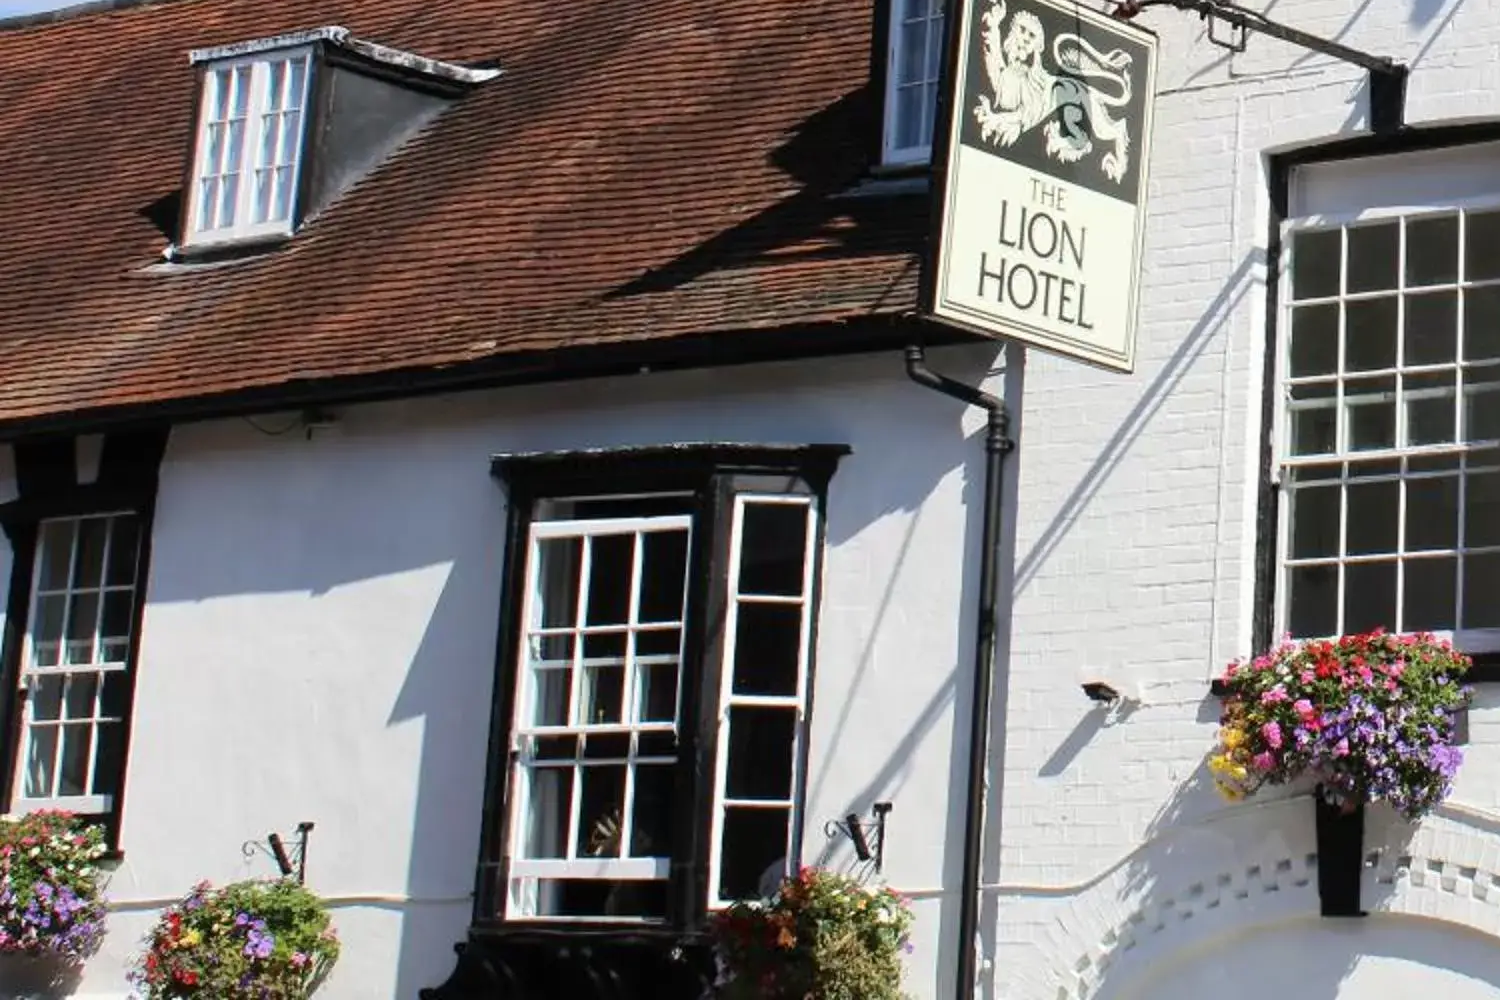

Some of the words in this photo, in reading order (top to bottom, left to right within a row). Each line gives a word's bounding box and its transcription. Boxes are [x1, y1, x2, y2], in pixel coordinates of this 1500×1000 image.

[1030, 179, 1067, 211] THE
[998, 199, 1086, 271] LION
[977, 251, 1094, 330] HOTEL
